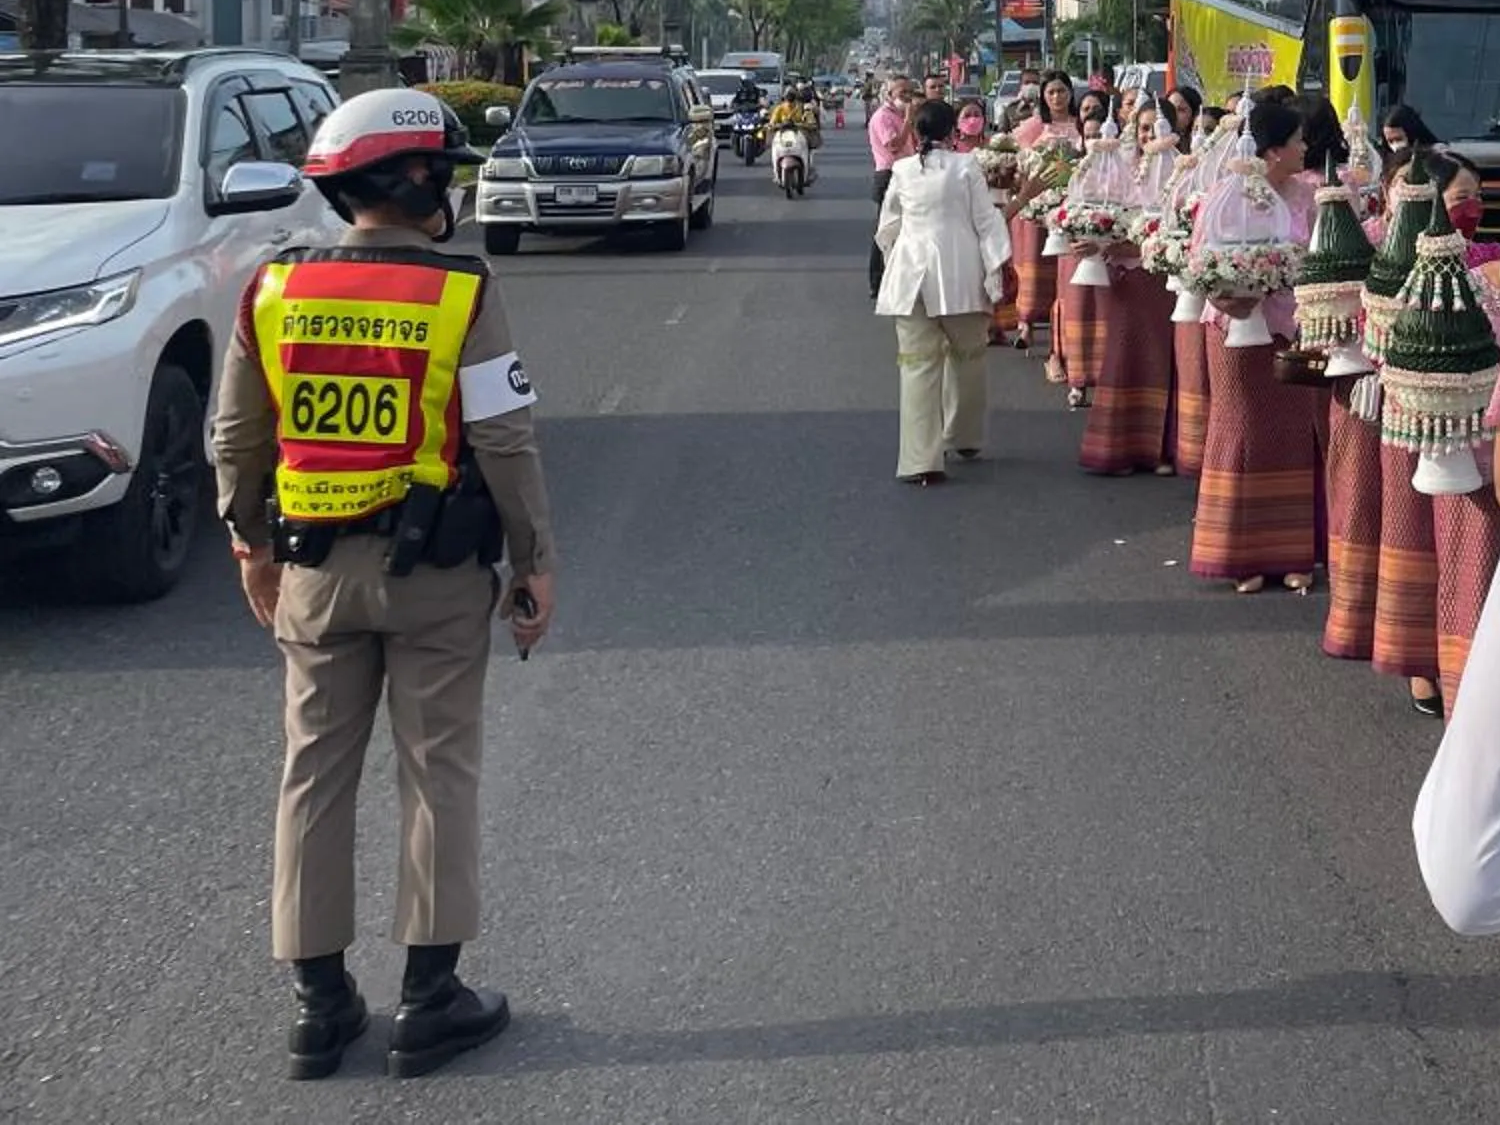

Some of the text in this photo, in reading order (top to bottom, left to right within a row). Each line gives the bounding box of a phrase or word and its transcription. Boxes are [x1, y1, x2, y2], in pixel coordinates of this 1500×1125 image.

[391, 110, 440, 126] 6206
[283, 304, 429, 342] ตำรวจจราจร
[291, 380, 400, 436] 6206
